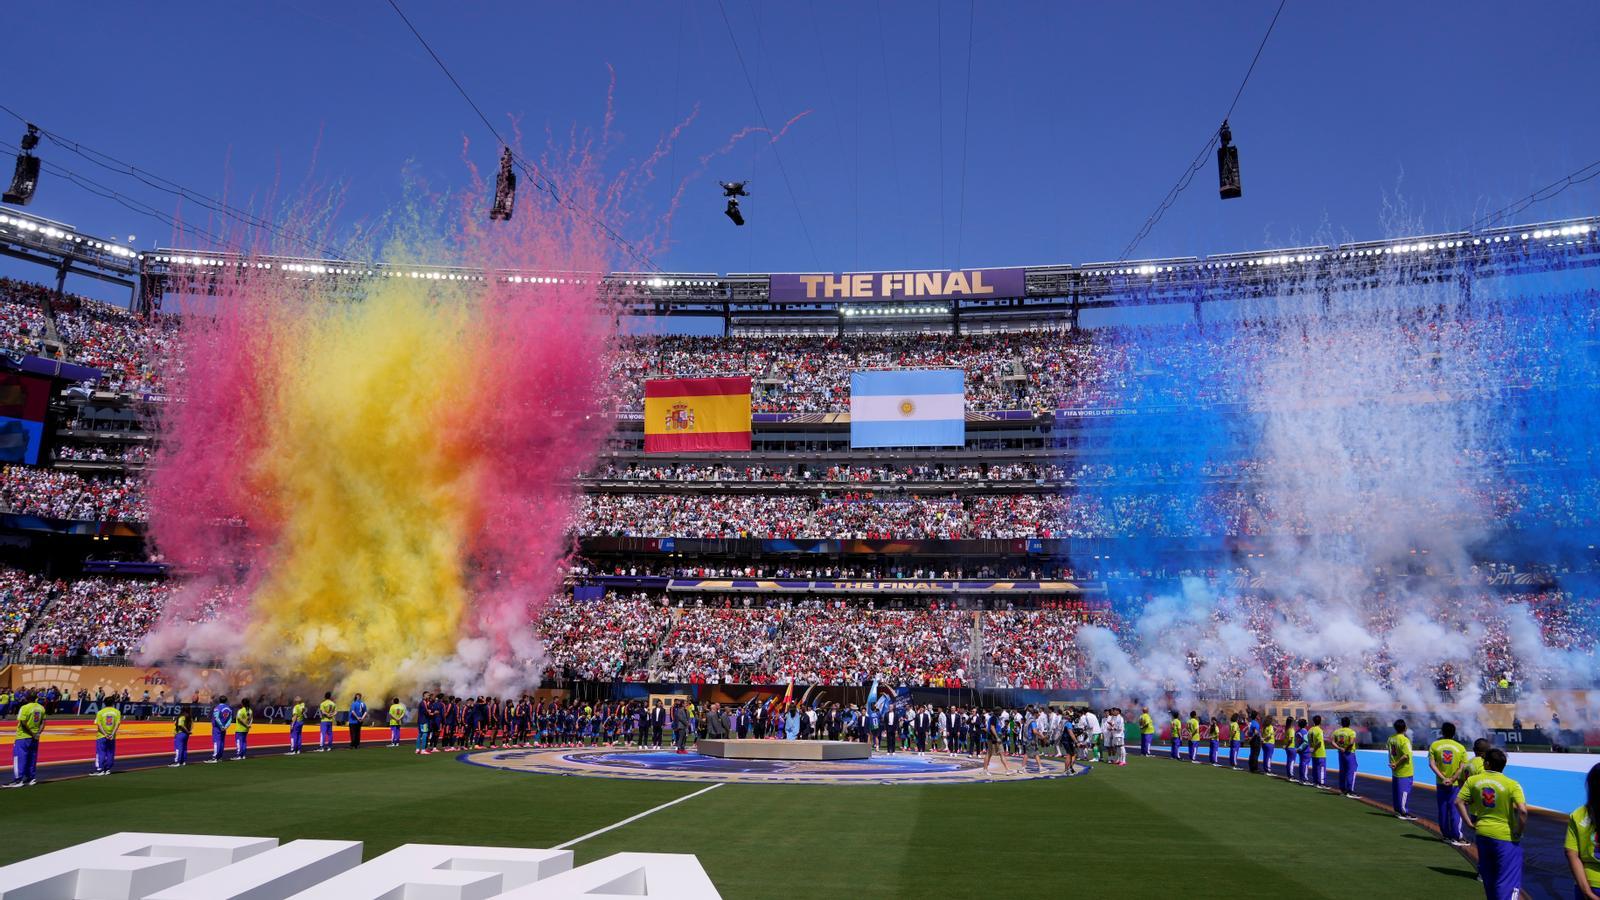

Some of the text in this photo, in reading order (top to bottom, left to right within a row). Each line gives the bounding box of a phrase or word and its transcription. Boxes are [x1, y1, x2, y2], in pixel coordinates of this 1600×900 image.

[800, 271, 994, 298] THE FINAL
[832, 582, 944, 590] THE FINAL
[144, 677, 168, 685] FIFA
